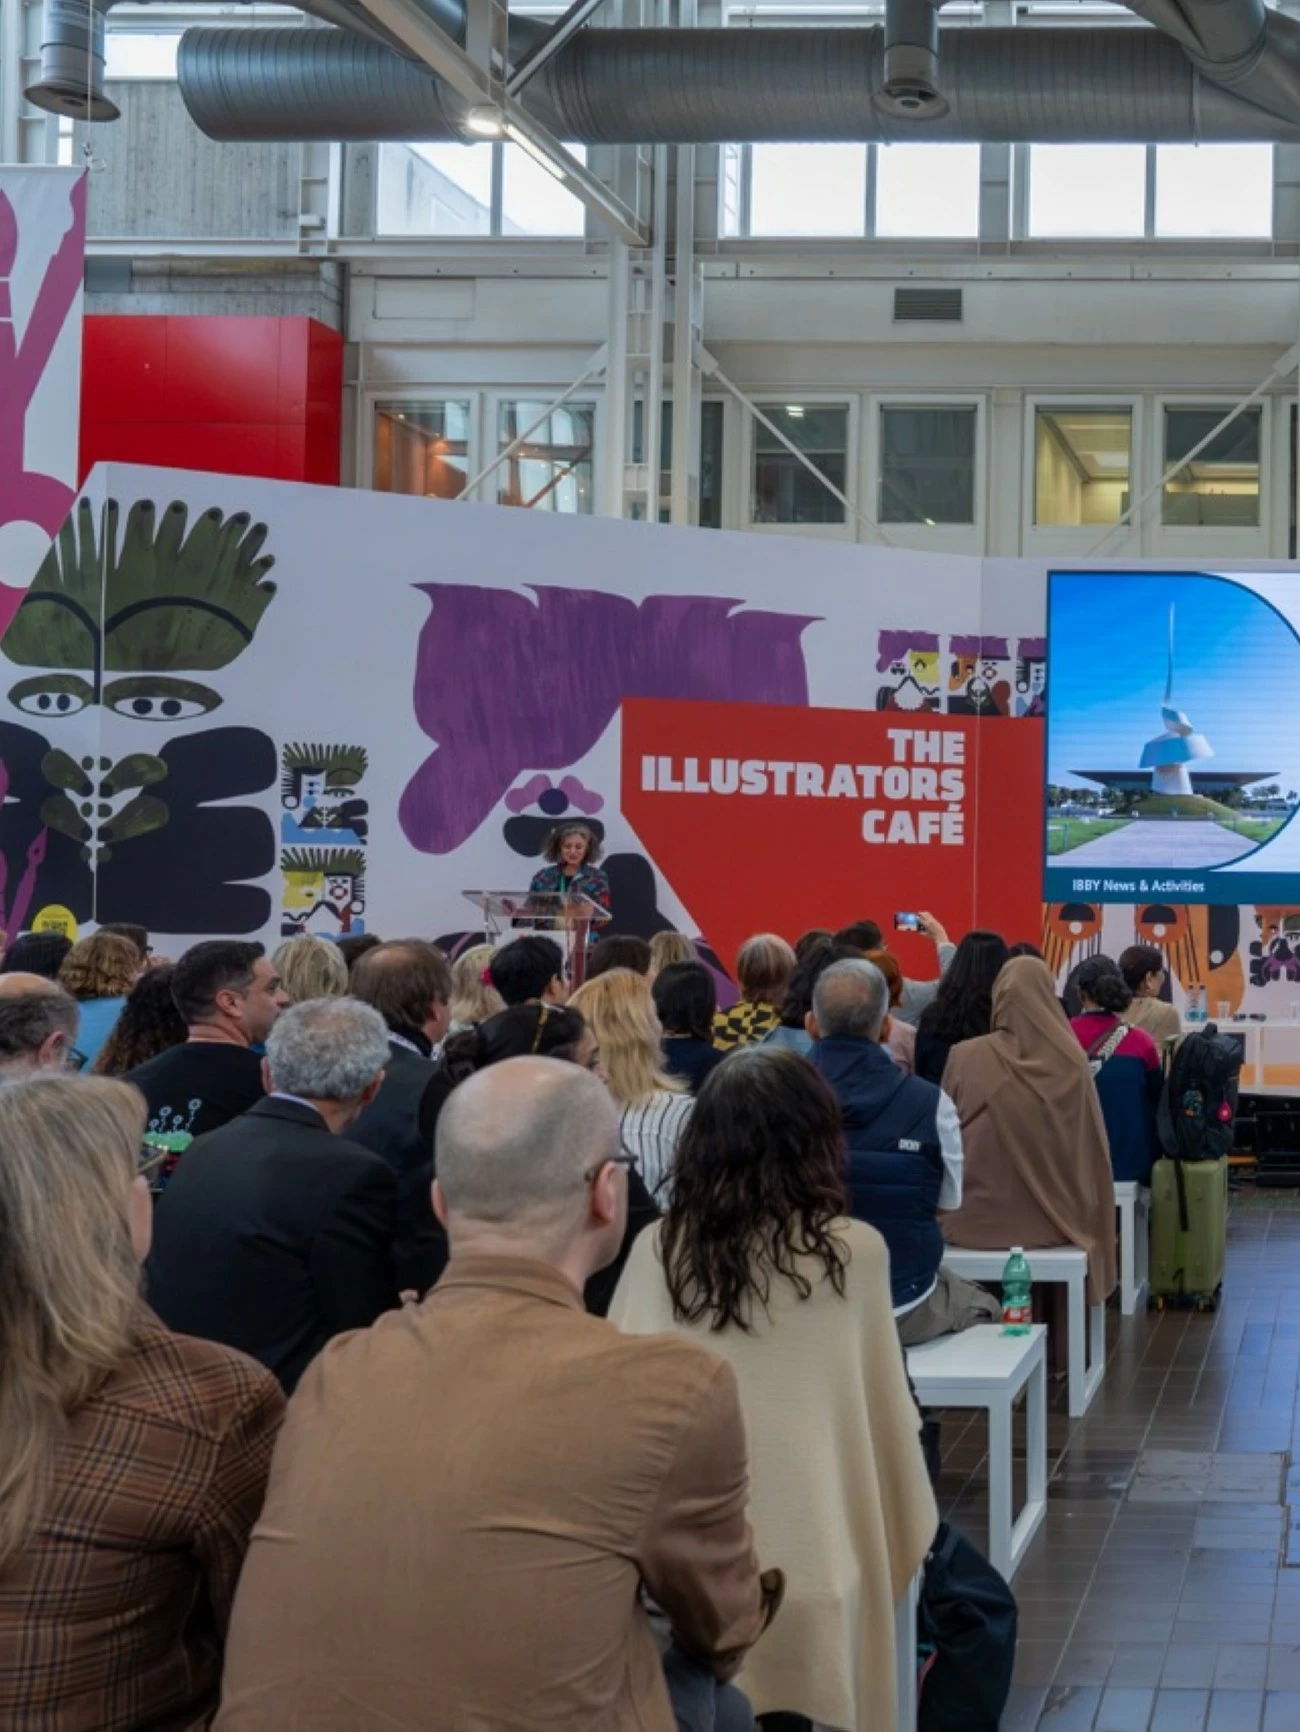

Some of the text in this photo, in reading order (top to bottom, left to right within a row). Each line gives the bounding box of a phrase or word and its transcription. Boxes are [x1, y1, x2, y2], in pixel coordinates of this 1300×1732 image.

[888, 728, 965, 764] THE
[641, 755, 965, 801] ILLUSTRATORS
[861, 803, 965, 845] CAFÉ
[1072, 879, 1205, 892] IBBY News & Activities
